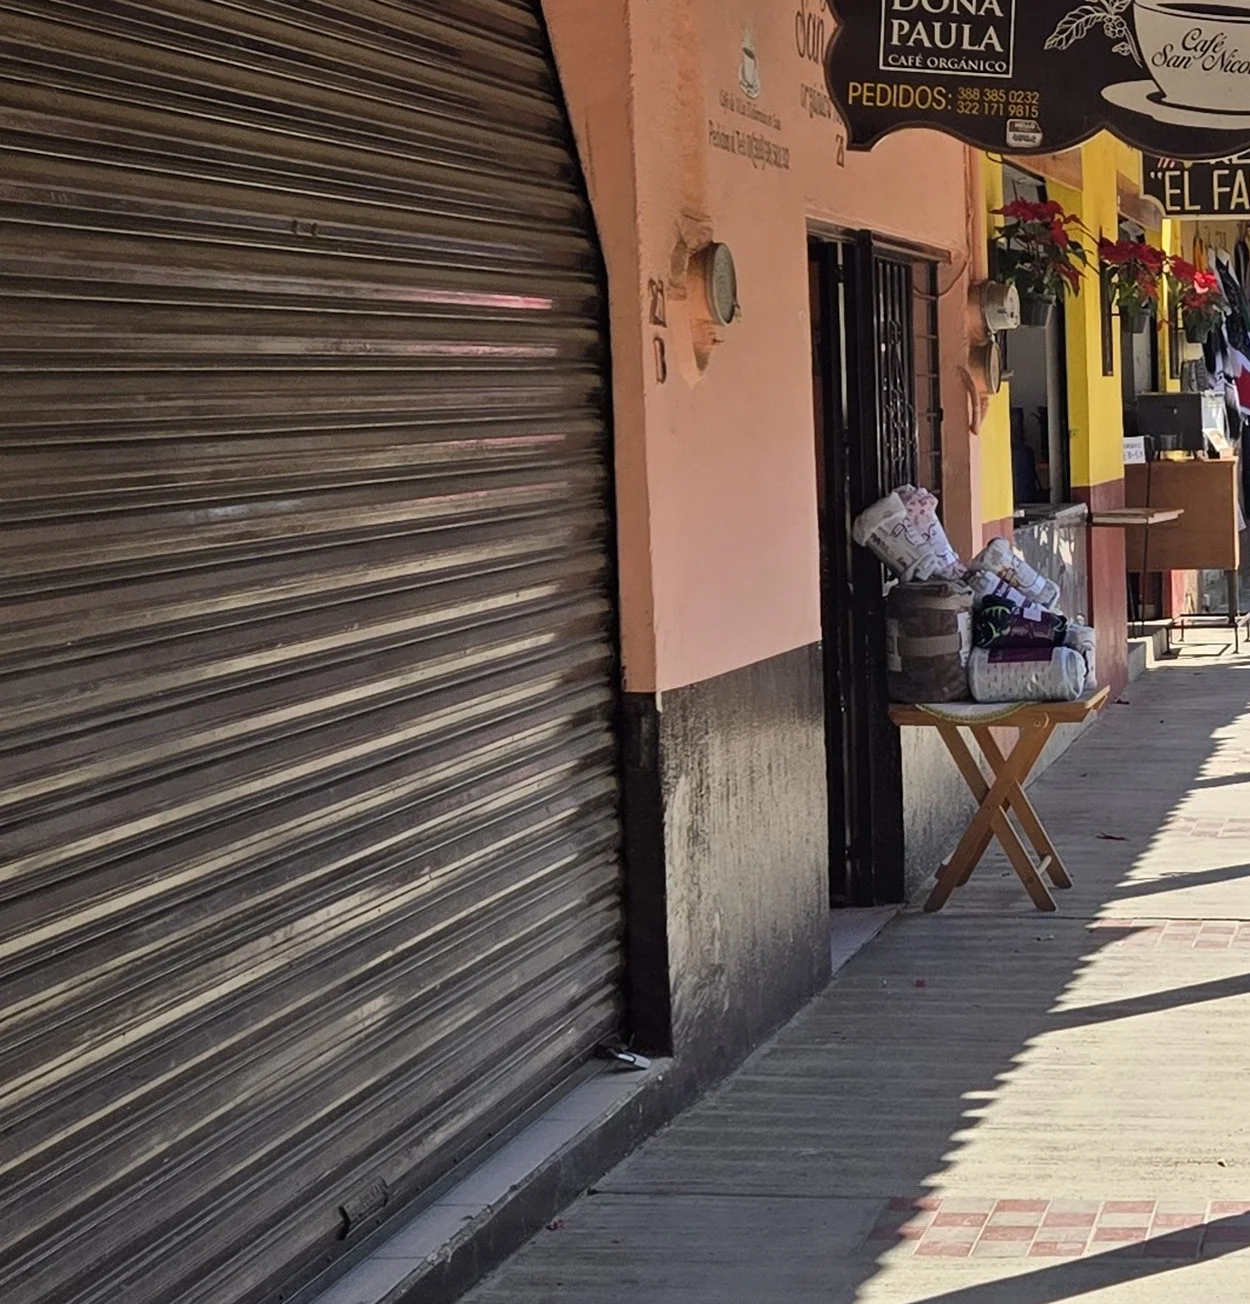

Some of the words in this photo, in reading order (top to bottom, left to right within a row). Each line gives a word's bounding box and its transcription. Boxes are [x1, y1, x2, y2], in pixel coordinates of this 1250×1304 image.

[891, 19, 1004, 52] PAULA
[1181, 27, 1228, 60] Café
[888, 54, 924, 67] CAFÉ
[926, 57, 1007, 72] ORGÁNICO
[1151, 43, 1193, 70] San
[848, 81, 952, 110] PEDIDOS:
[957, 87, 981, 101] 388
[983, 88, 1006, 102] 385
[1008, 90, 1040, 104] 0232
[957, 101, 979, 115] 322
[984, 103, 1004, 116] 171
[1008, 104, 1040, 118] 9815
